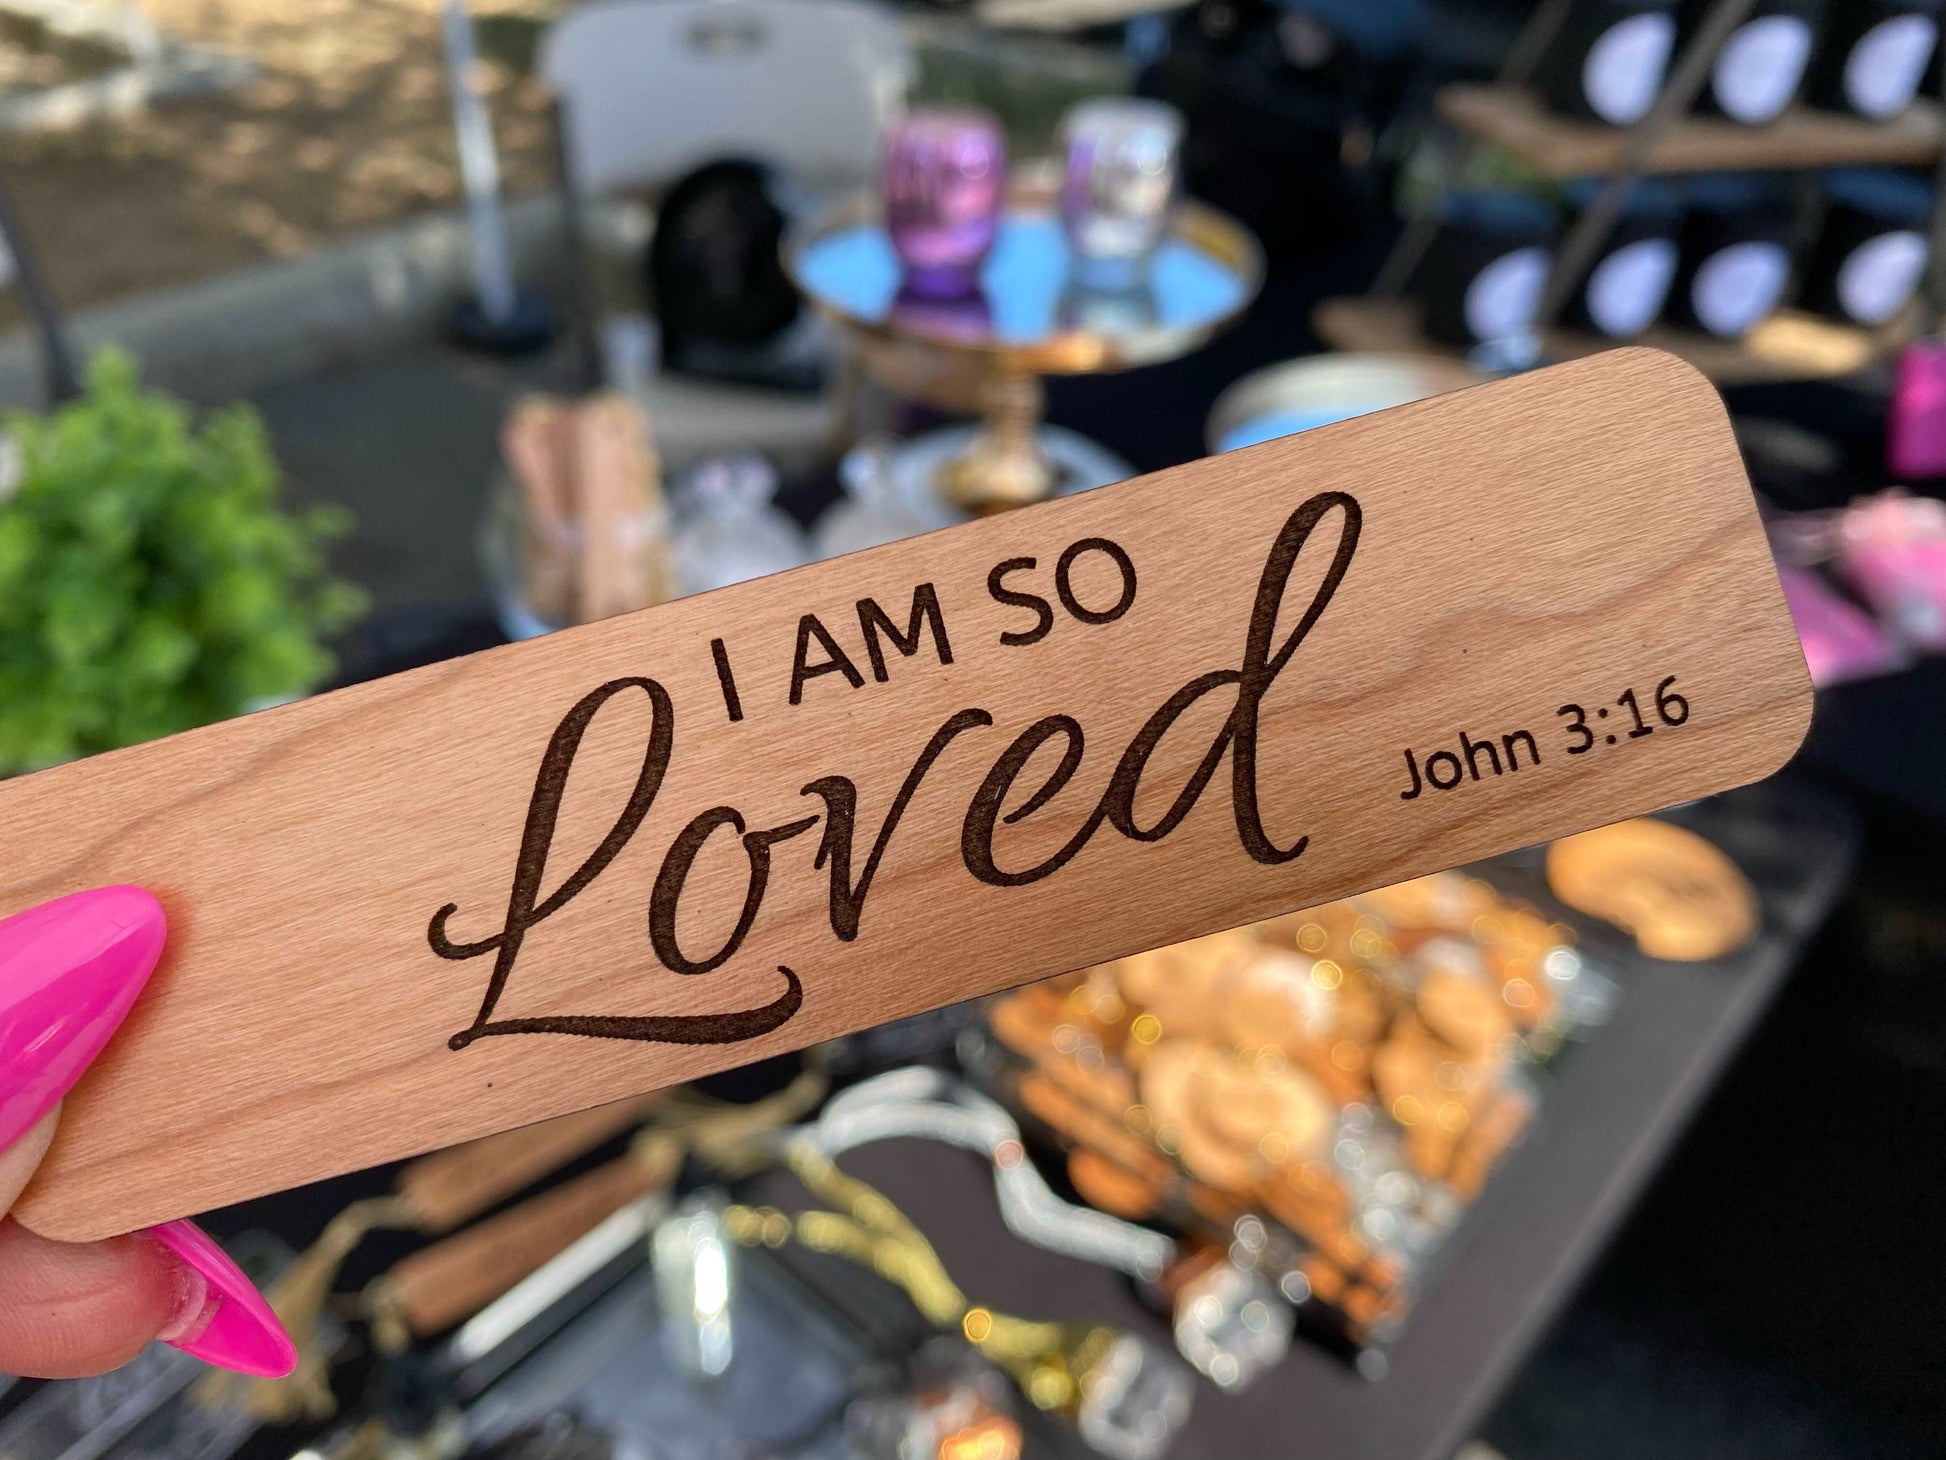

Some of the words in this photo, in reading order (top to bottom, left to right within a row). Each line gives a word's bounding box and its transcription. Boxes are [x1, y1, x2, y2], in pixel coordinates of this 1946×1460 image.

[710, 637, 745, 723] I
[788, 582, 955, 707] AM
[986, 536, 1138, 647] SO
[427, 490, 1363, 1052] Loved
[1399, 729, 1543, 802] John
[1555, 674, 1691, 756] 3:16
